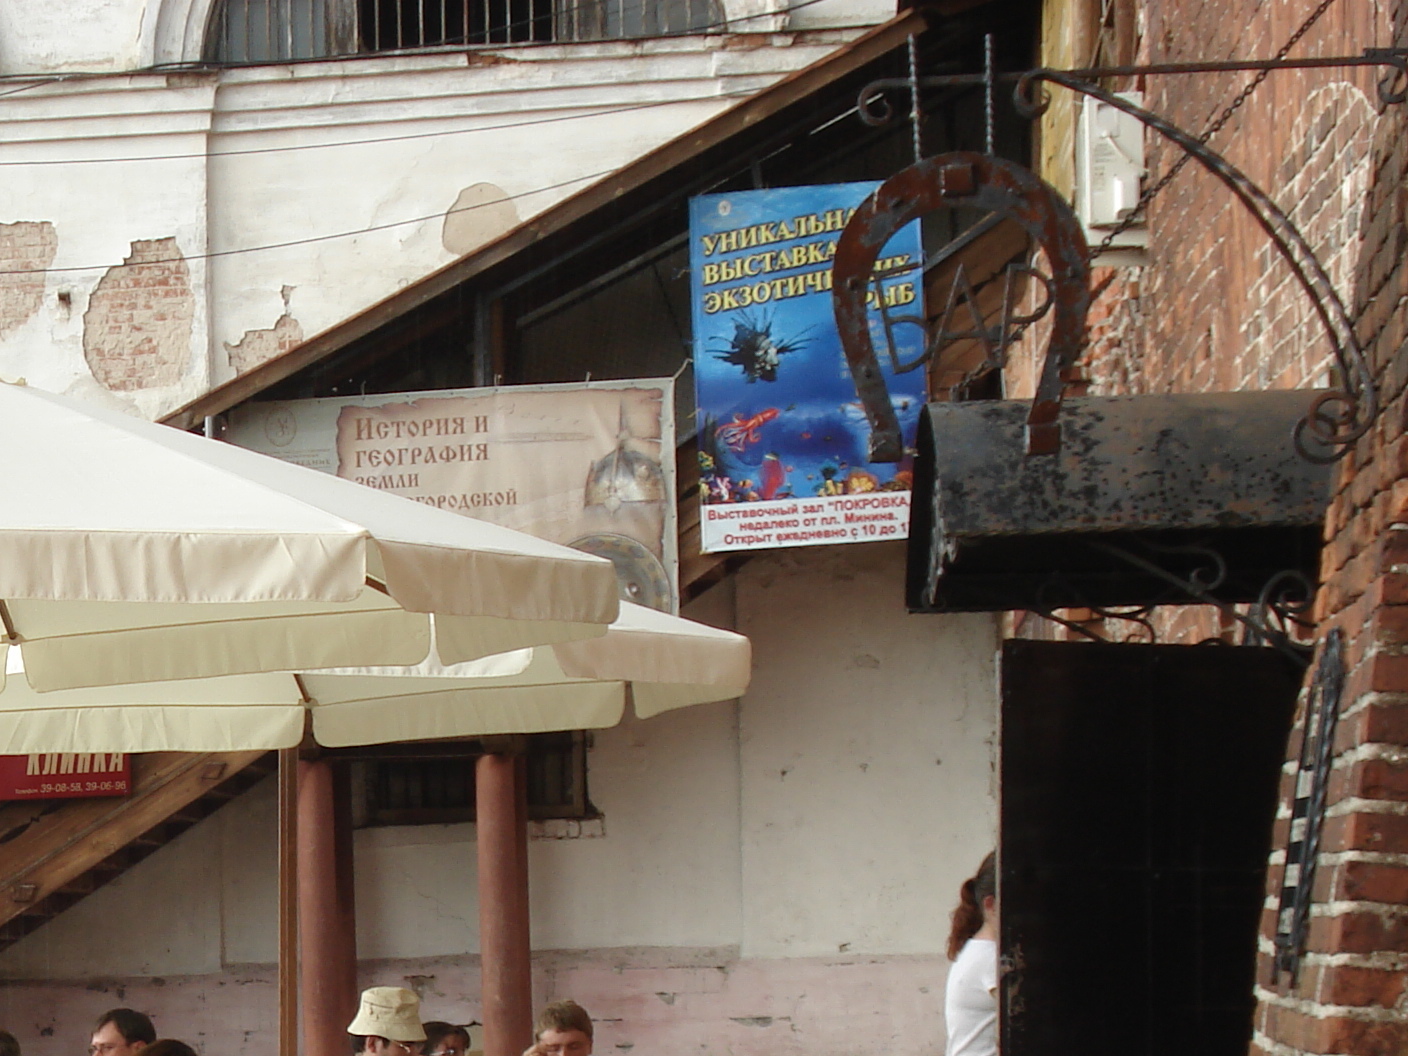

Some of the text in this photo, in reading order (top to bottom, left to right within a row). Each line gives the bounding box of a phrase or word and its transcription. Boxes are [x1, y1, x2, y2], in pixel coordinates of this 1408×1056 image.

[703, 240, 838, 286] ВЫСТАВКА
[878, 263, 1055, 373] БАР
[707, 504, 799, 521] Выставочный
[802, 502, 825, 515] зал
[739, 511, 898, 531] недалеко от пл. Минина.
[724, 533, 773, 548] Открыт
[776, 528, 848, 545] ежедневно
[851, 527, 860, 537] с
[862, 523, 877, 536] 10
[880, 523, 899, 536] до
